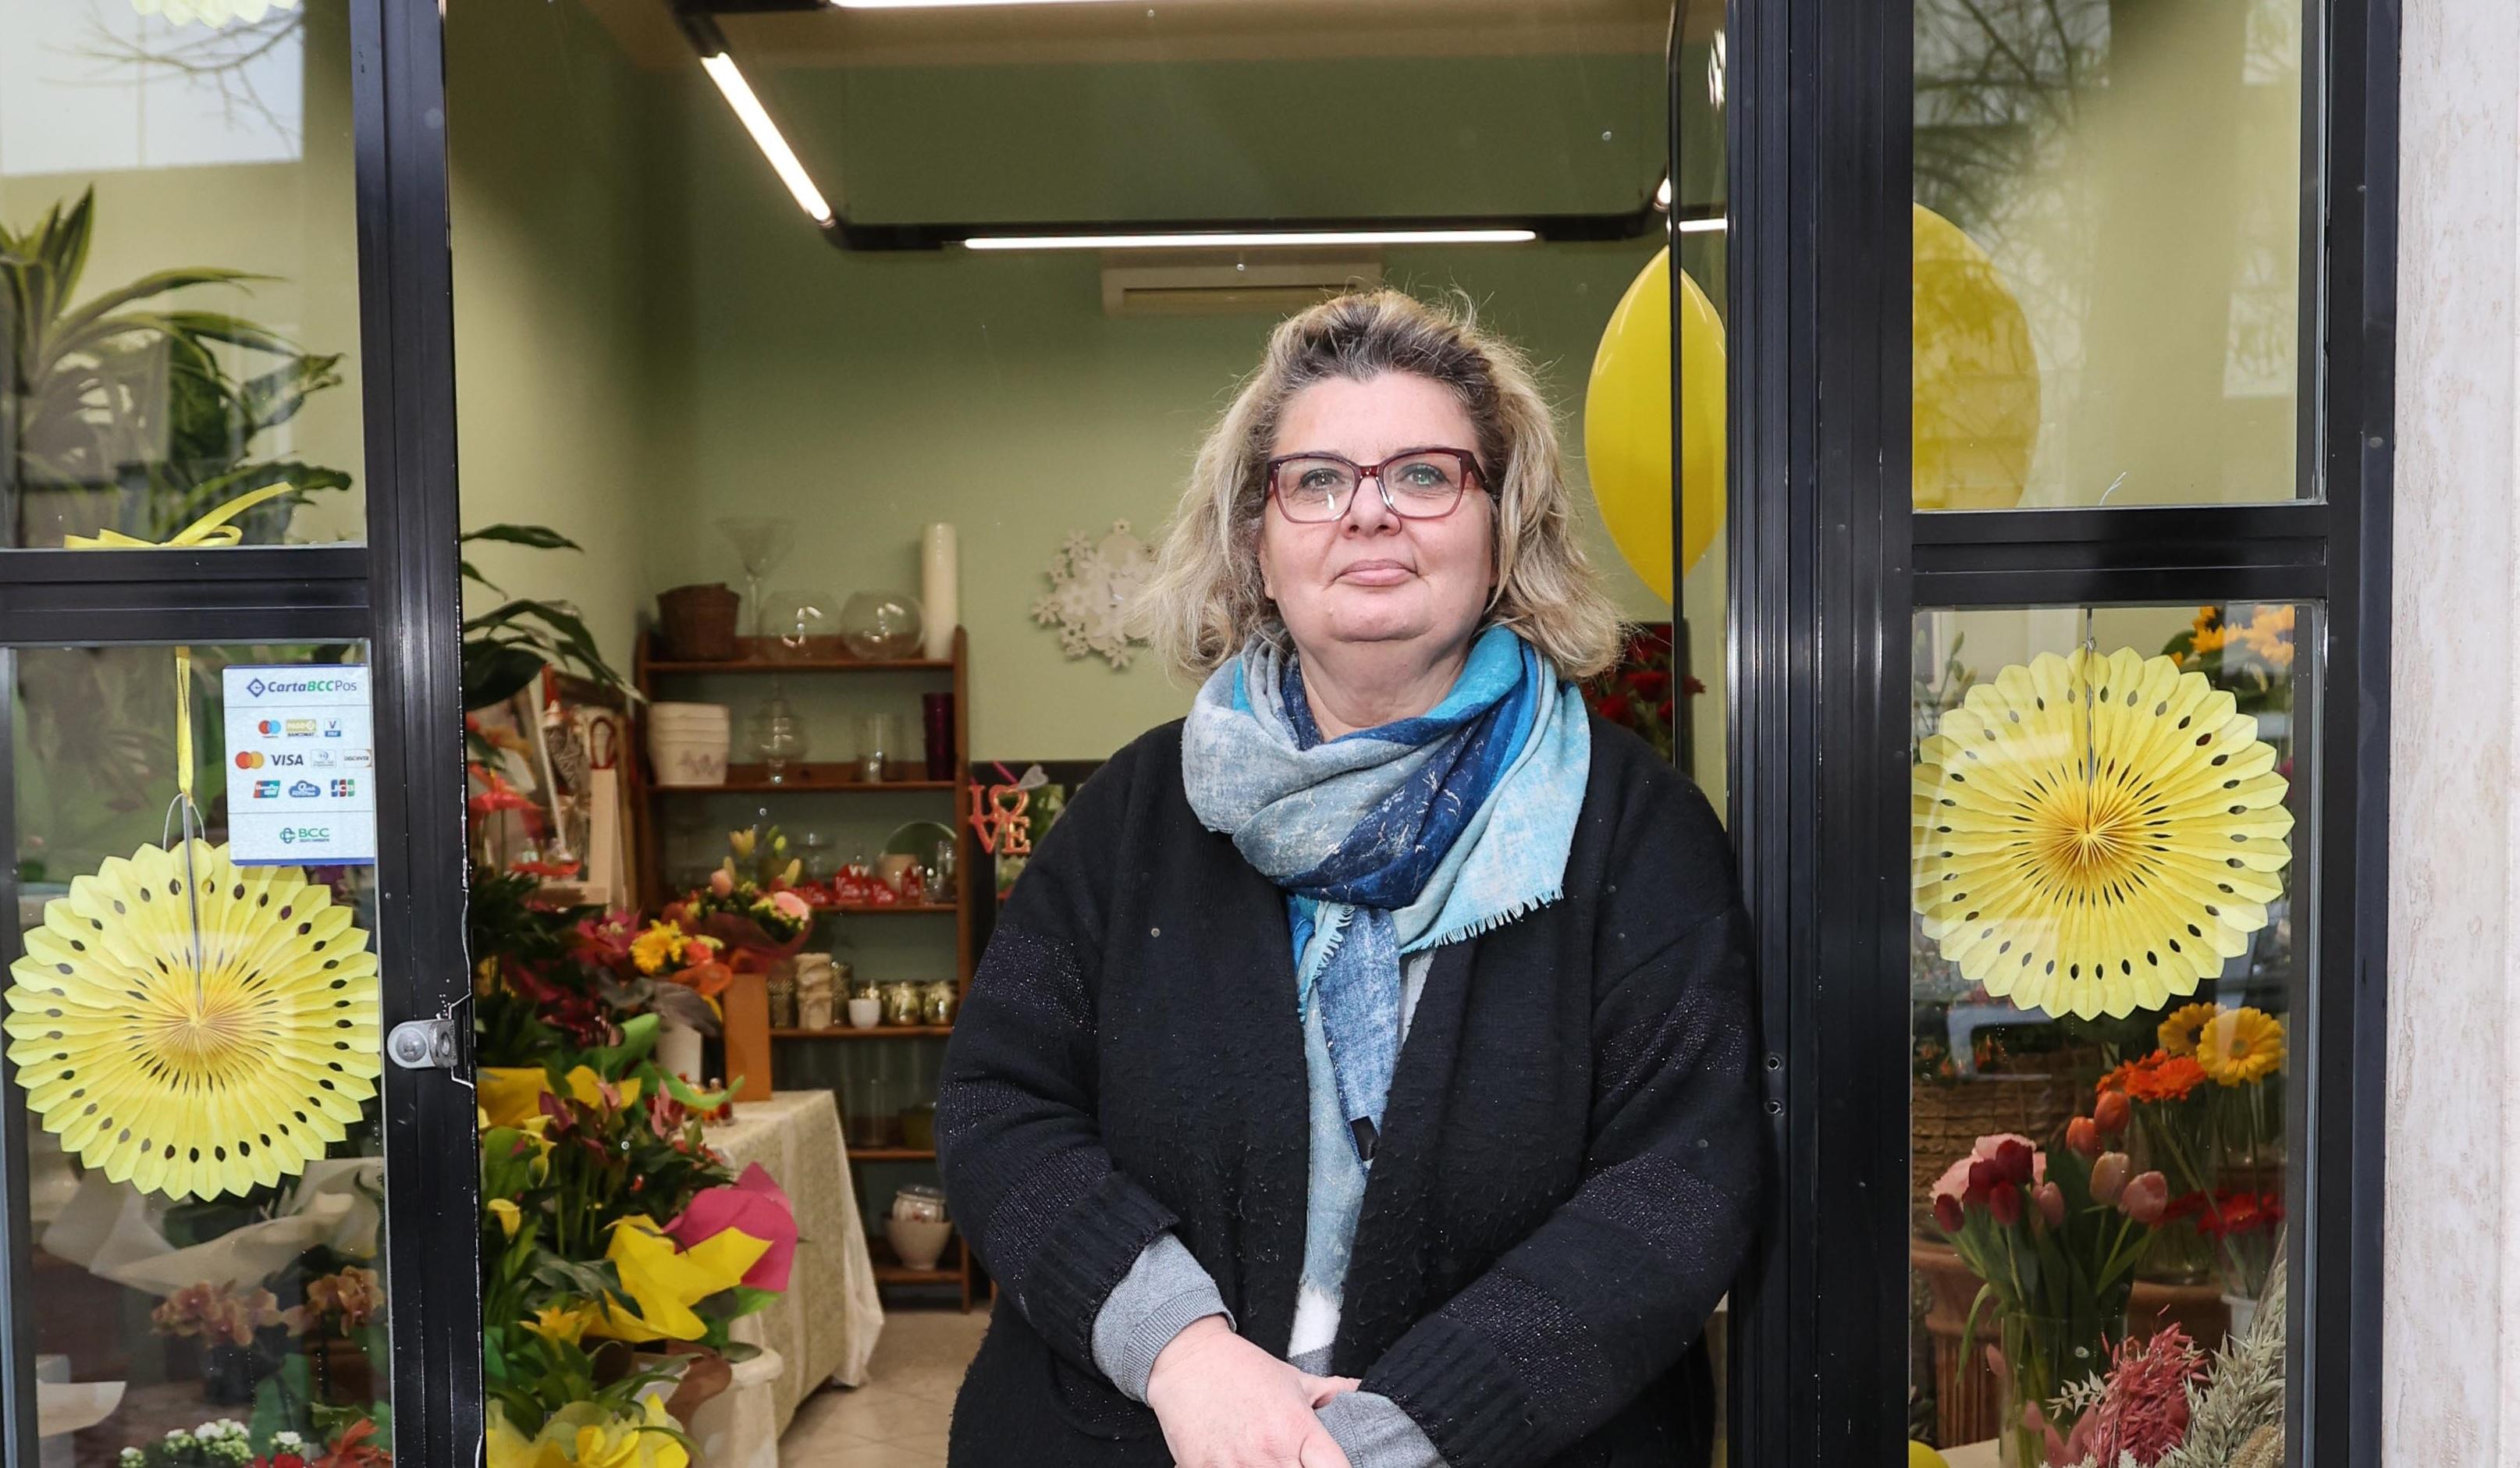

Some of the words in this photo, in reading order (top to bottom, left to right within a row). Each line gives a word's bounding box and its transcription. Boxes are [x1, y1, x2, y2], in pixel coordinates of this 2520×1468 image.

[268, 681, 357, 692] CartaBCCPos
[271, 754, 304, 766] VISA
[298, 828, 329, 837] BCC
